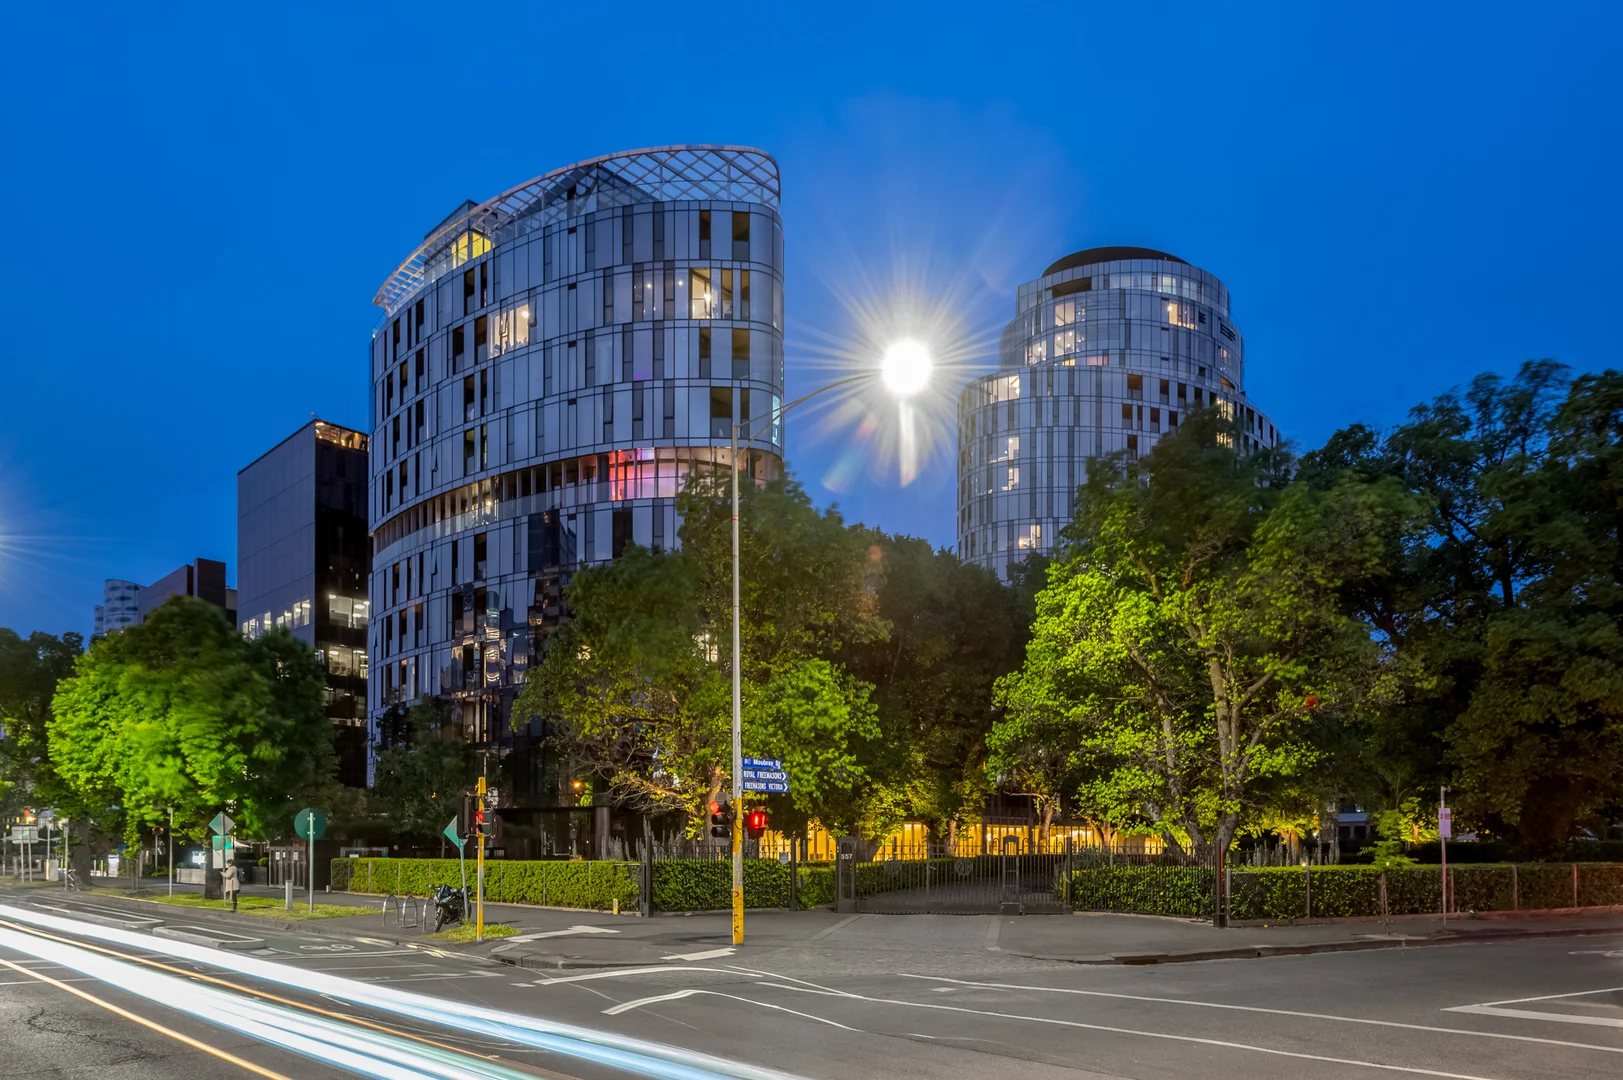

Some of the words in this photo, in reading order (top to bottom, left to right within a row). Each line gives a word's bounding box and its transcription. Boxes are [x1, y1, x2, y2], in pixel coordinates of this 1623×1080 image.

[753, 758, 774, 767] Moubray
[743, 770, 755, 779] ROYAL
[757, 771, 782, 780] FREEMASONS
[744, 782, 766, 790] FREEMASONS
